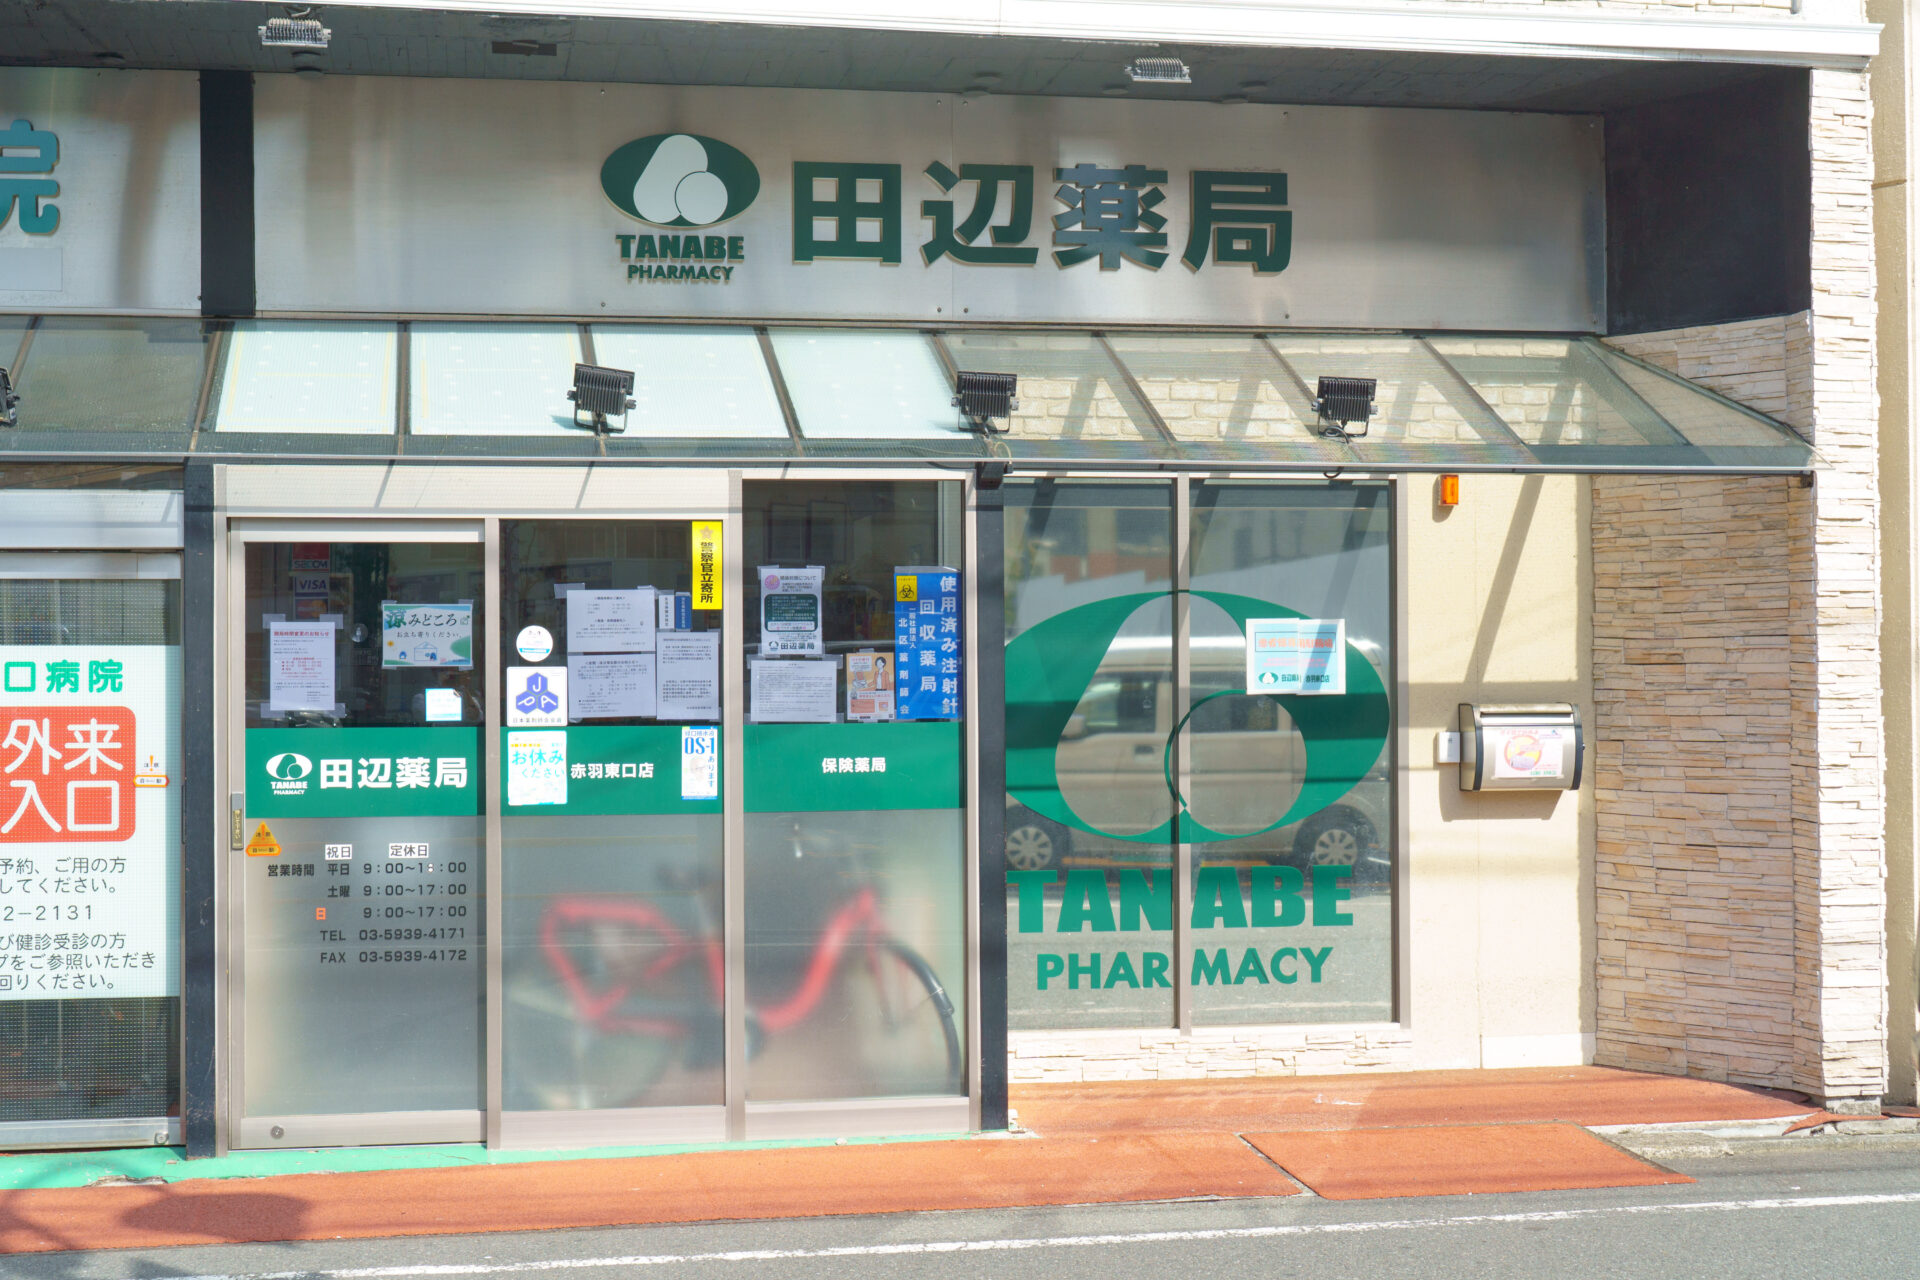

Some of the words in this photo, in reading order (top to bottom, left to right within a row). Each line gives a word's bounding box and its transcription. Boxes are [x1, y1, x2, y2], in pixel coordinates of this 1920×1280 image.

[791, 159, 1293, 273] 田辺薬局
[615, 233, 745, 260] TANABE
[626, 264, 736, 282] PHARMACY
[294, 560, 328, 569] SECOM
[700, 541, 713, 603] 警察官立寄所
[299, 580, 327, 590] VISA
[386, 608, 457, 628] 涼みどころ
[919, 599, 937, 693] 回収薬局
[940, 576, 958, 714] 使用済み注射針
[898, 617, 909, 715] 北区薬剤師会
[4, 659, 124, 693] 口病院
[1, 717, 124, 776] 外来
[684, 737, 715, 755] OS-1
[511, 748, 564, 766] お休み
[822, 757, 887, 774] 保険薬局
[320, 757, 468, 789] 田辺薬局
[570, 763, 655, 779] 赤羽東口店
[271, 781, 308, 789] TANABE
[0, 779, 120, 833] 入口
[326, 846, 352, 859] 祝日
[390, 844, 428, 858] 定休日
[267, 864, 315, 877] 営業時間
[327, 863, 350, 876] 平日
[327, 885, 350, 898] 土曜
[1006, 864, 1354, 933] TANABE
[316, 907, 326, 920] 日
[320, 930, 346, 941] TEL
[359, 928, 465, 941] 03-5939-4171
[320, 952, 346, 963] FAX
[359, 950, 467, 963] 03-5939-4172
[1037, 947, 1334, 990] PHARMACY
